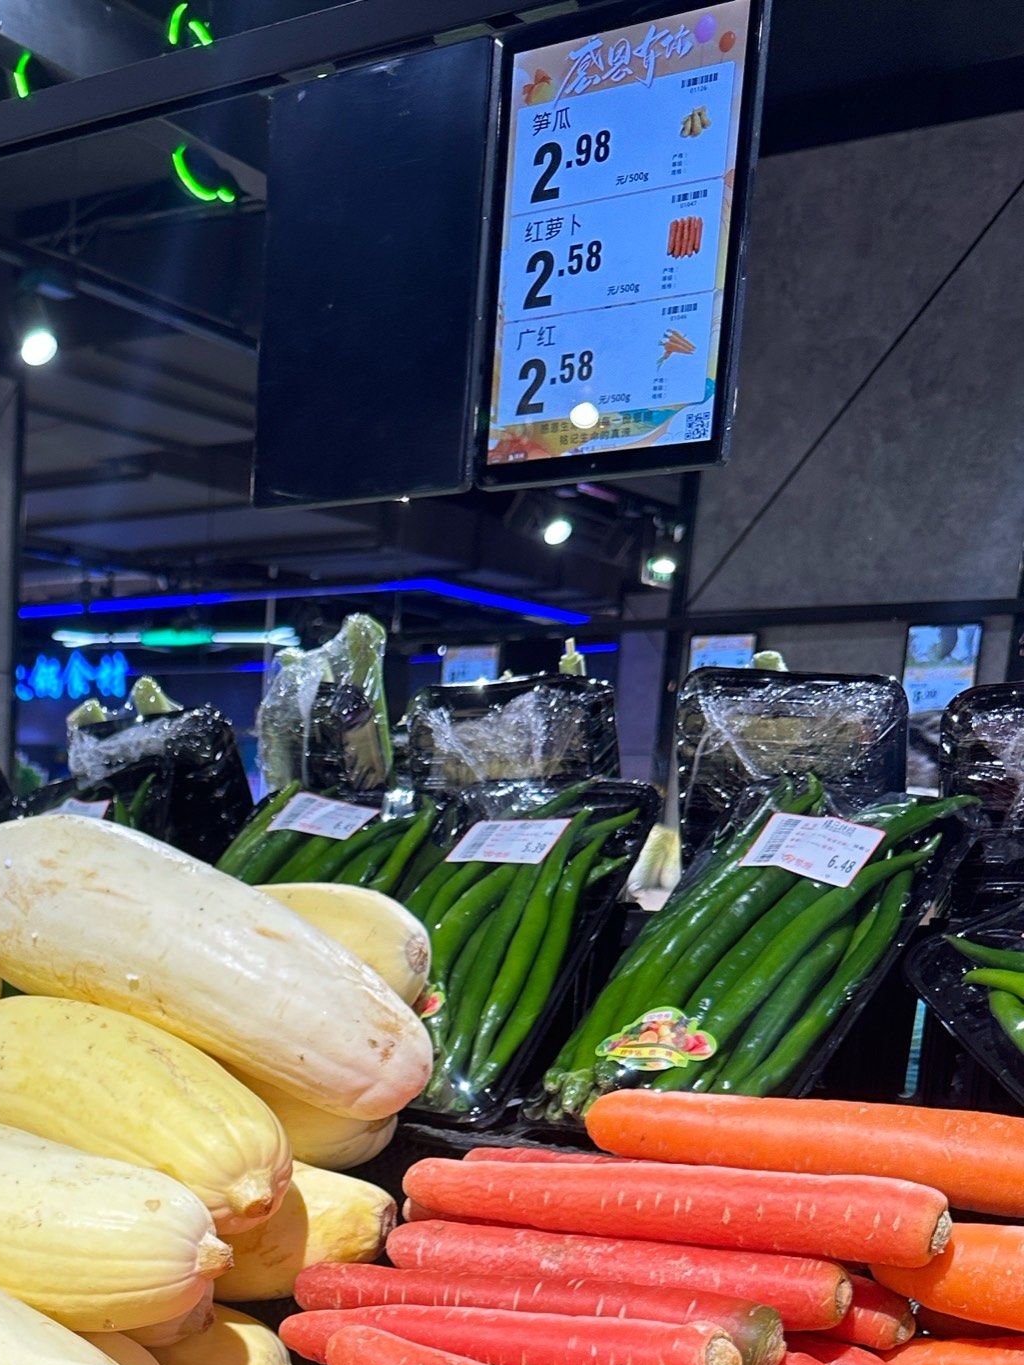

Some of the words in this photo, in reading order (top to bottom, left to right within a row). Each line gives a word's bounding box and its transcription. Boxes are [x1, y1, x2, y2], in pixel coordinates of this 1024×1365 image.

[532, 106, 571, 136] 笋瓜
[530, 129, 611, 204] 2.98
[615, 171, 650, 186] 元/500g
[524, 213, 582, 243] 红萝卜
[523, 239, 603, 310] 2.58
[606, 282, 641, 297] 元/500g
[516, 325, 556, 351] 广红
[515, 349, 594, 416] 2.58
[597, 392, 632, 406] 元/500g
[827, 854, 857, 874] 6.48
